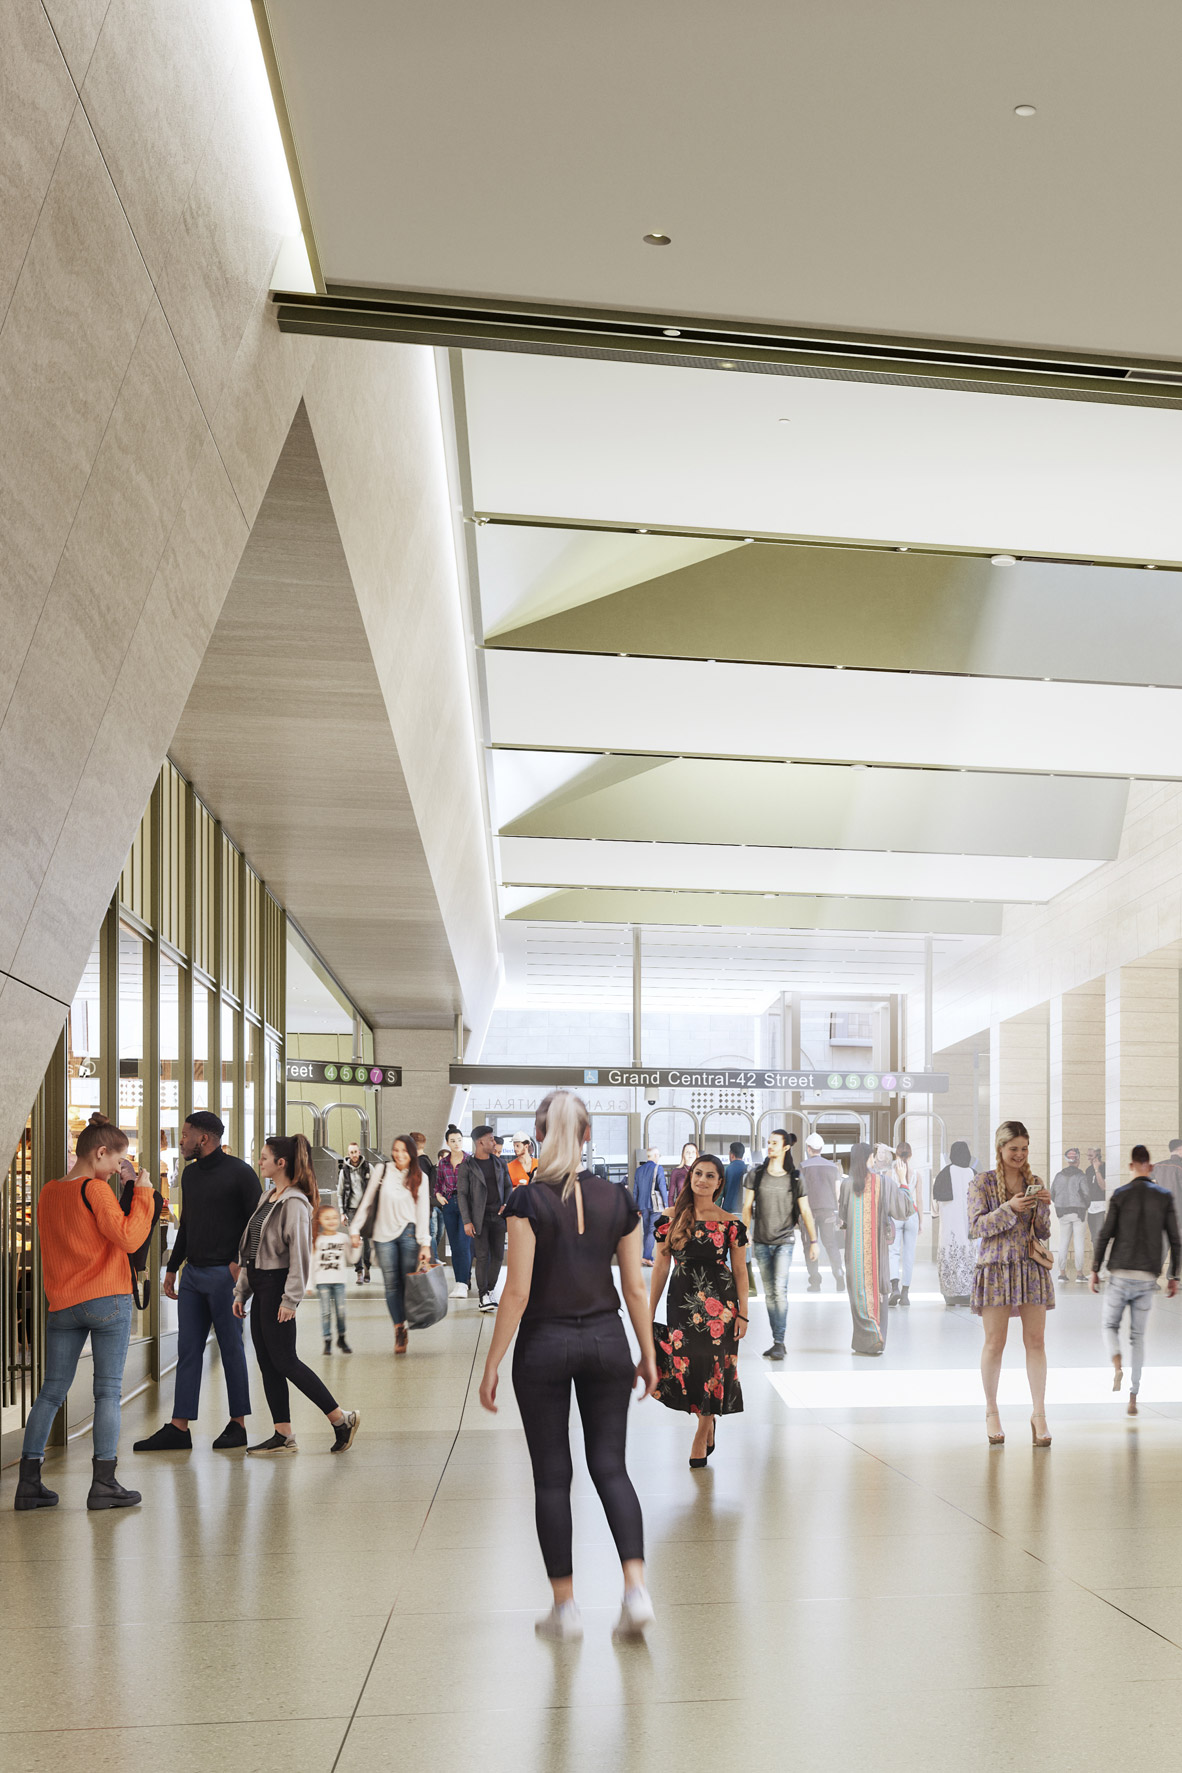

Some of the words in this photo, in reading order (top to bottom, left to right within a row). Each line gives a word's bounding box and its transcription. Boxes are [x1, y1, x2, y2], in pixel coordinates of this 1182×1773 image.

[328, 1064, 335, 1078] 4
[343, 1066, 350, 1079] 5
[358, 1067, 365, 1080] 6
[387, 1071, 395, 1083] S
[608, 1070, 660, 1085] Grand
[668, 1071, 756, 1086] Central-42
[764, 1073, 814, 1087] Street
[830, 1075, 839, 1087] 4
[849, 1075, 857, 1087] 5
[867, 1076, 875, 1087] 6
[902, 1076, 911, 1088] S
